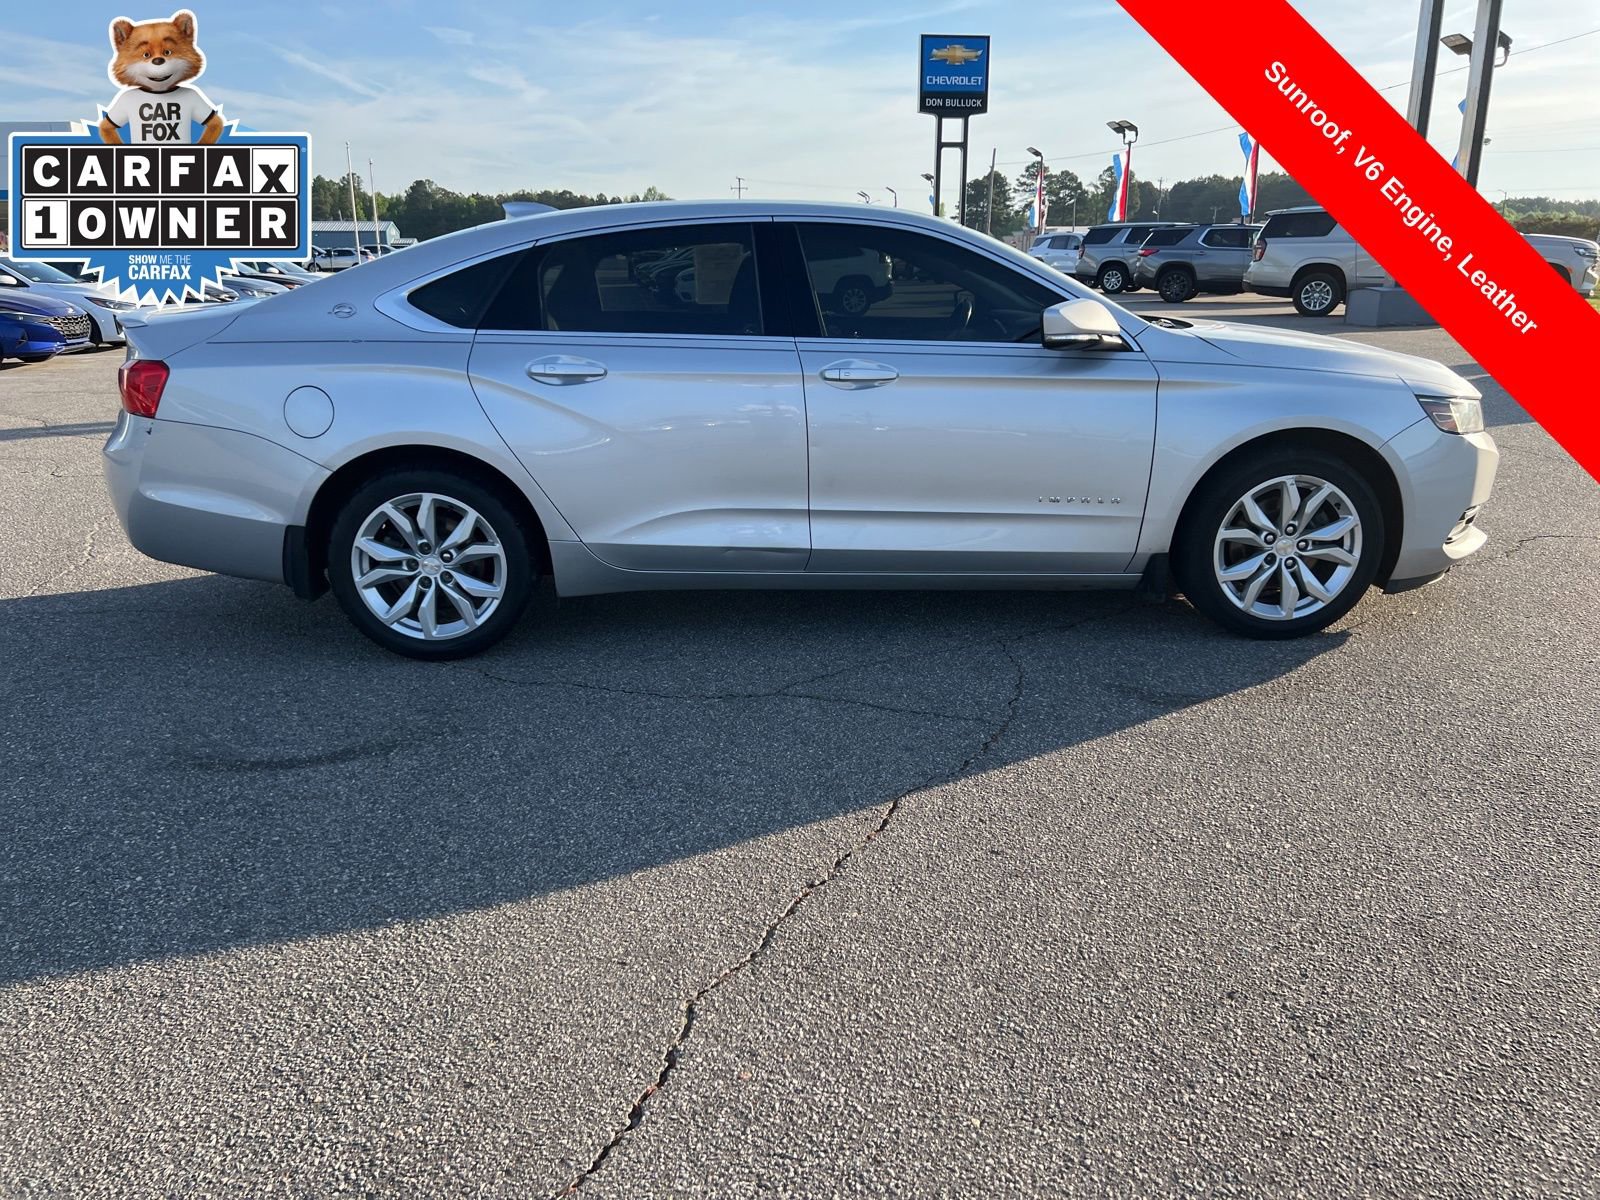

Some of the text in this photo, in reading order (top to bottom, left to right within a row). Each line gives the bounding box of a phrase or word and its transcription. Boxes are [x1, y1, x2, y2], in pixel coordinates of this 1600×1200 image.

[926, 76, 983, 85] CHEVROLET
[925, 98, 982, 107] DON BULLUCK
[1038, 496, 1121, 504] IMPALA
